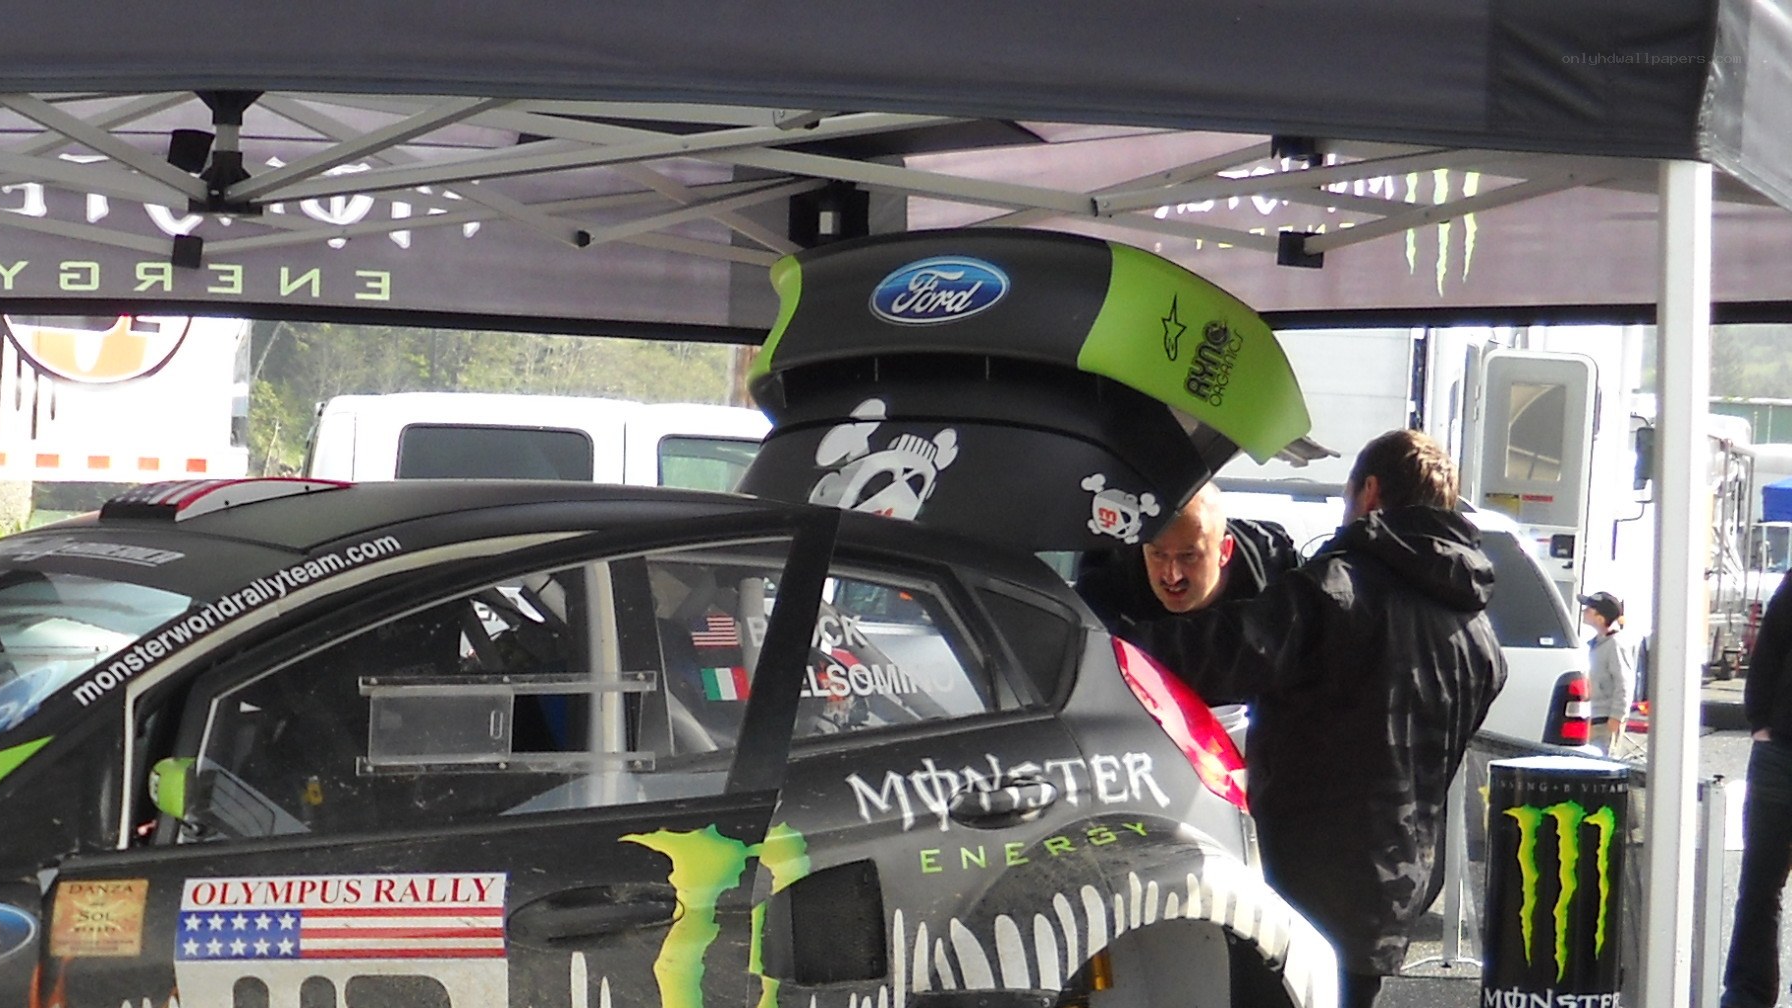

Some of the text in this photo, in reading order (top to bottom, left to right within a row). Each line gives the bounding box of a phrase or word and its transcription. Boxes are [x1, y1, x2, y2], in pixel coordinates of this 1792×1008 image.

[891, 268, 984, 314] Ford
[72, 532, 402, 707] monsterworldrallyteam.com
[844, 751, 1172, 833] MONSTER
[918, 821, 1148, 875] ENERGY
[191, 876, 497, 907] OLYMPUS RALLY
